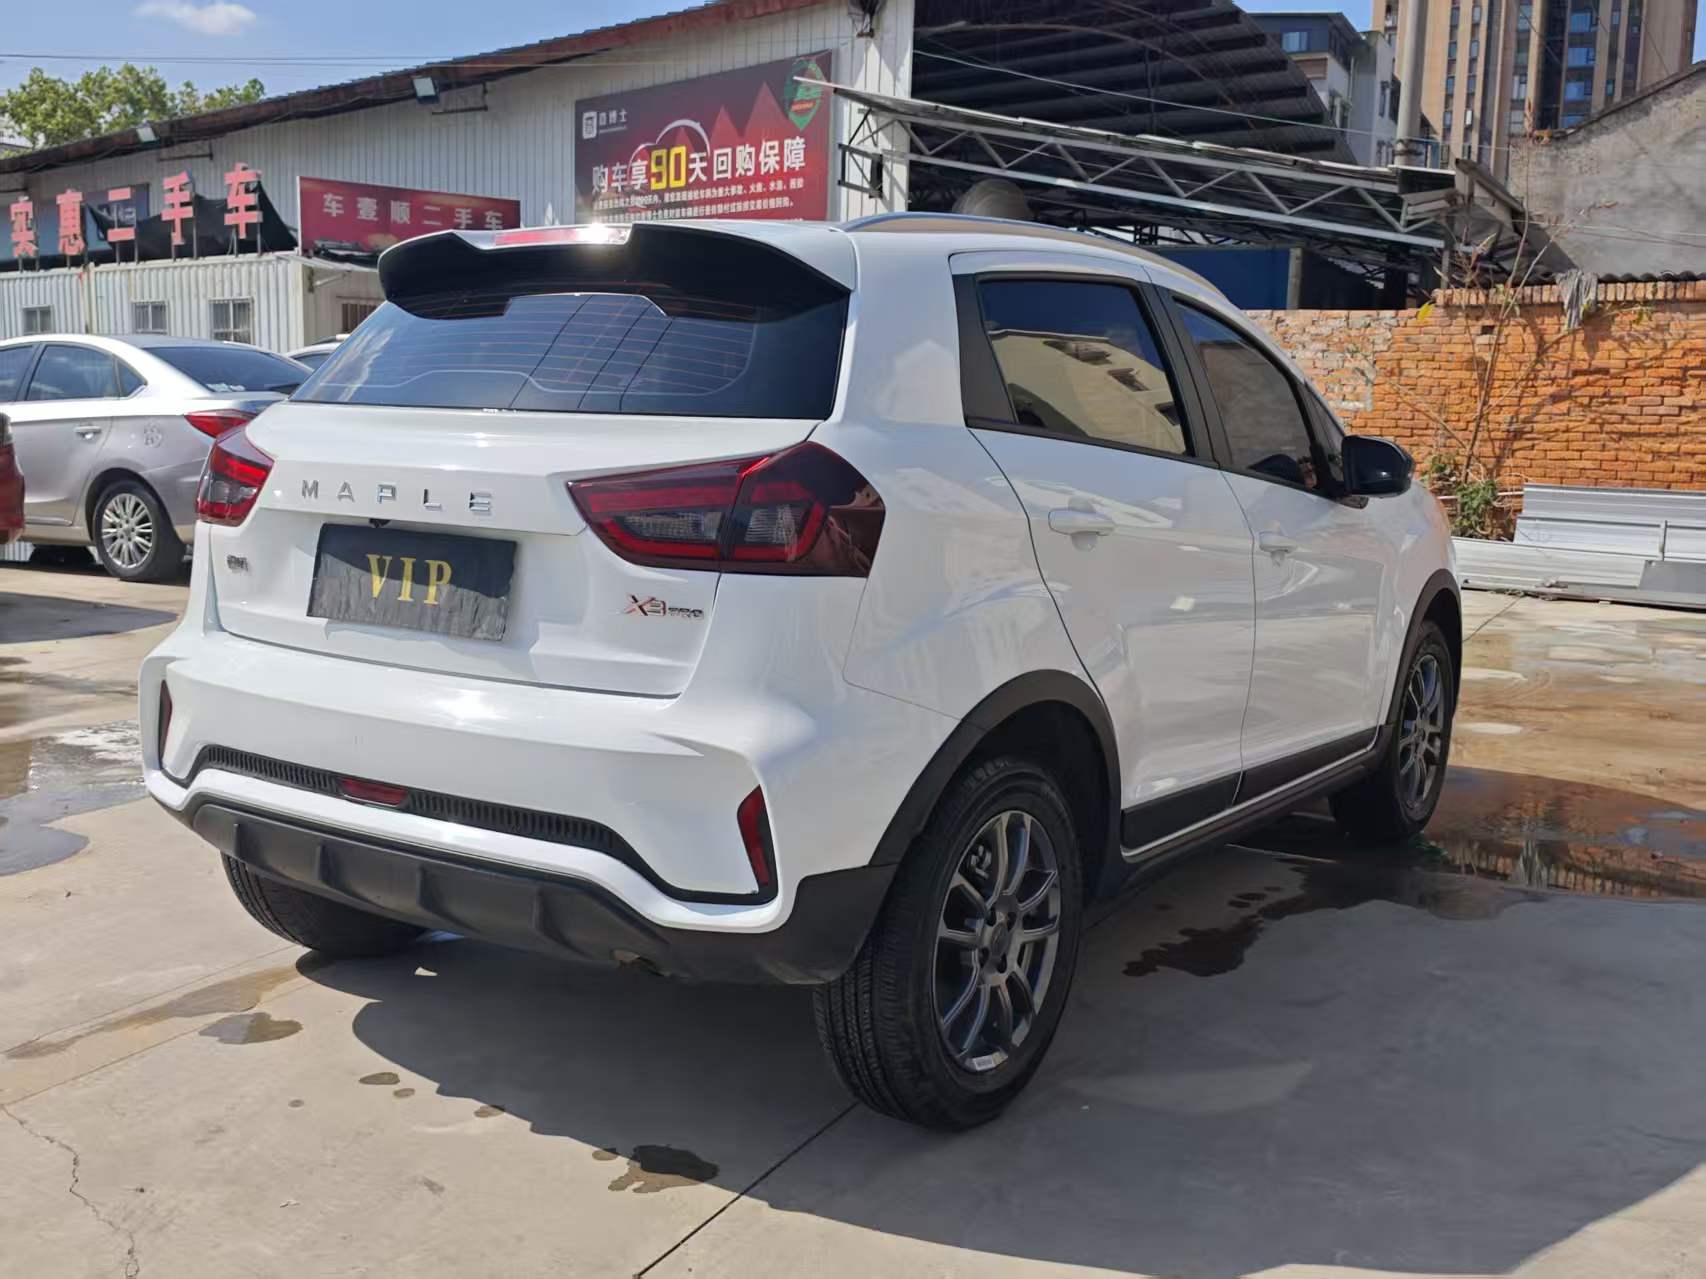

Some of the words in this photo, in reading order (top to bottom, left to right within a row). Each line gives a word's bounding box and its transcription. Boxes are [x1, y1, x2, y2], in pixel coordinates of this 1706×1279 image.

[592, 136, 806, 194] 购车享90天回购保障
[323, 193, 504, 230] 车壹顺二手车
[301, 479, 493, 514] MAPLE
[366, 554, 452, 605] VIP
